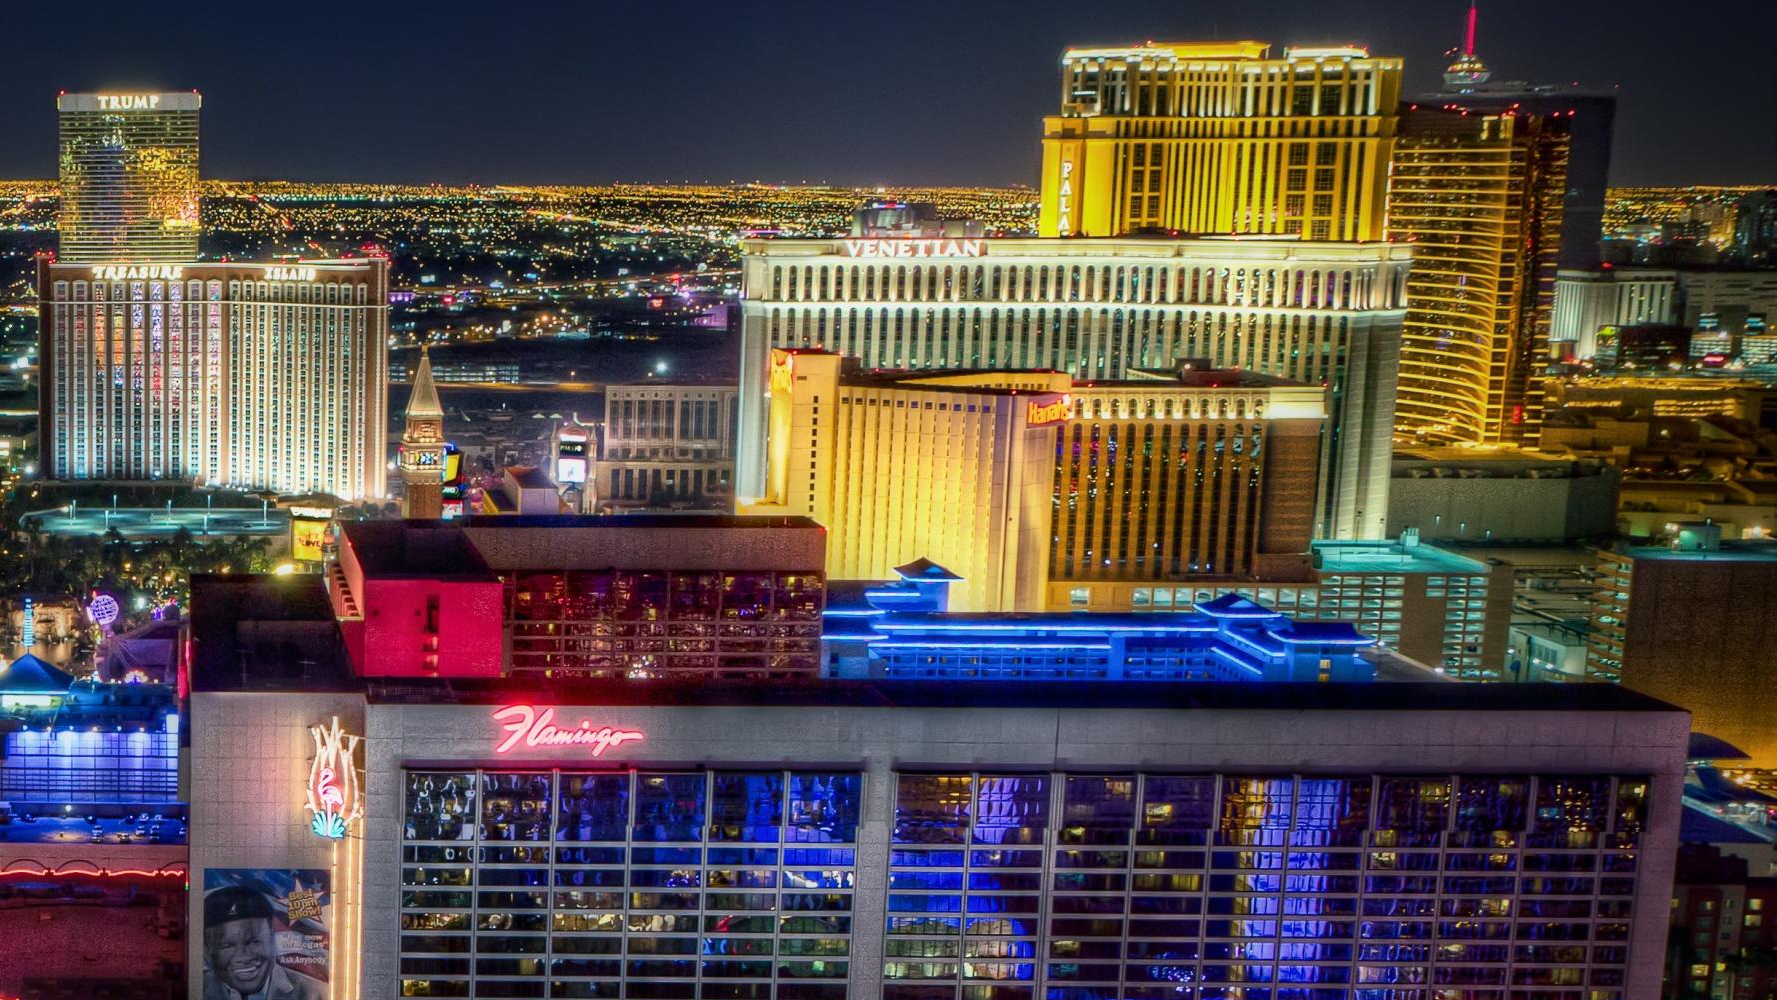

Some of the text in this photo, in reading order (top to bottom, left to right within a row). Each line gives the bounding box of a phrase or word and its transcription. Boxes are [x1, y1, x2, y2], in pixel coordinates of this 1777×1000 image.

[97, 95, 159, 110] TRUMP
[846, 239, 981, 258] VENETIAN
[92, 265, 316, 281] TREASURE ISLAND
[493, 704, 644, 757] Flamingo
[288, 888, 314, 900] Best
[288, 899, 319, 911] 10pm
[288, 906, 322, 920] Show!
